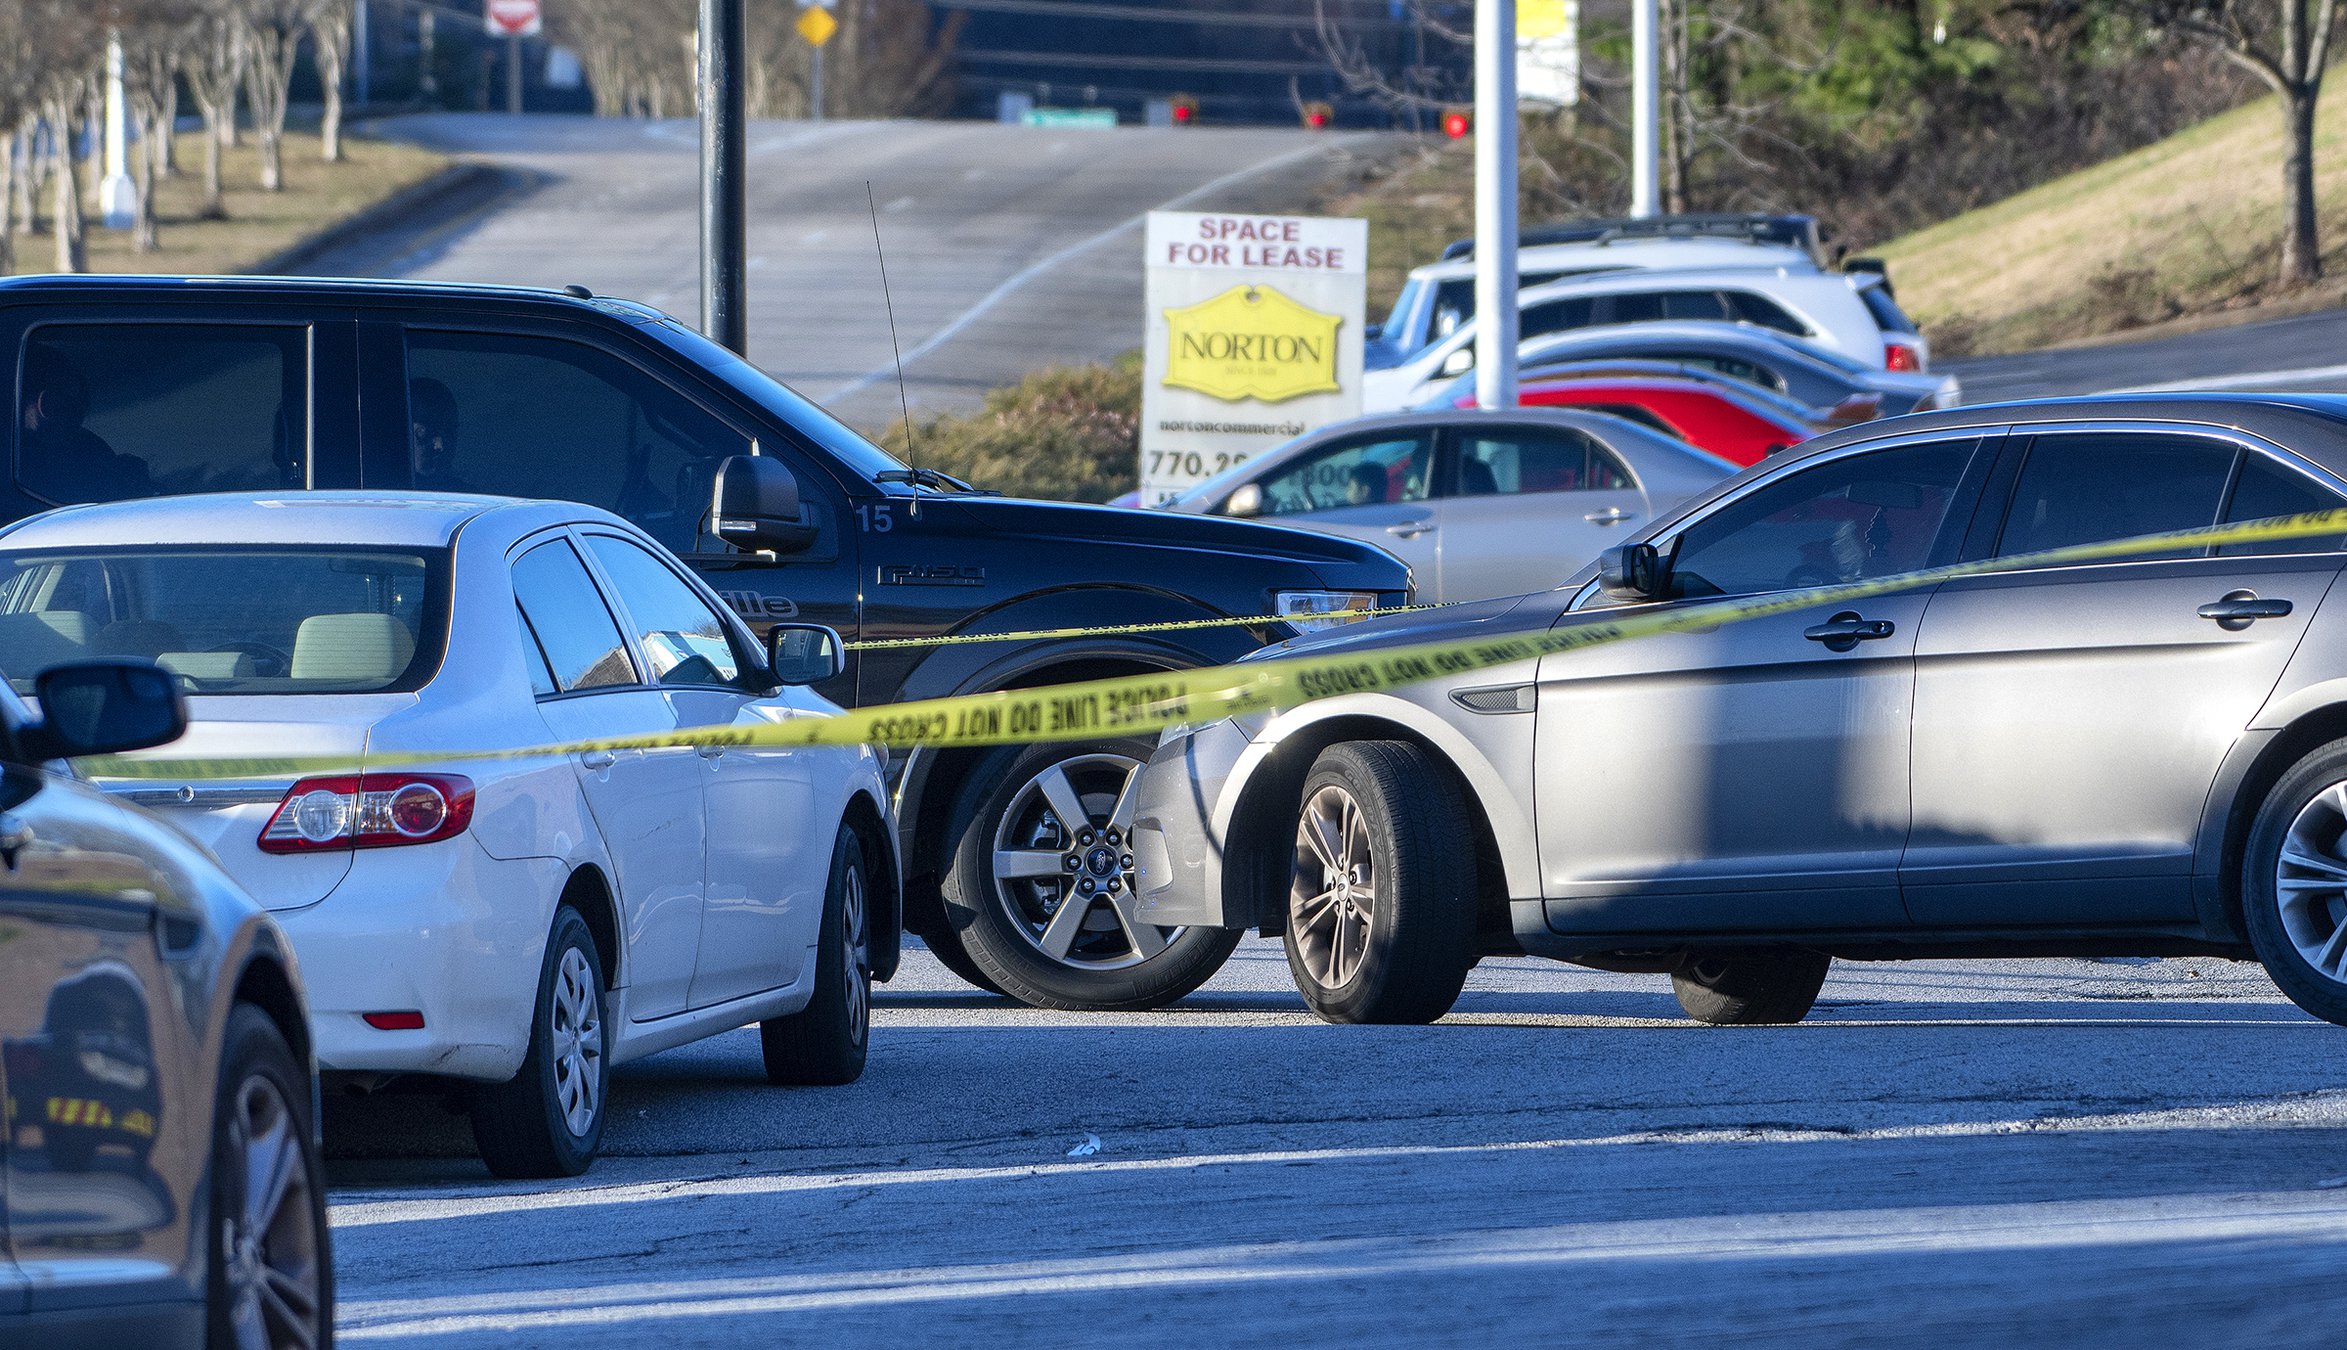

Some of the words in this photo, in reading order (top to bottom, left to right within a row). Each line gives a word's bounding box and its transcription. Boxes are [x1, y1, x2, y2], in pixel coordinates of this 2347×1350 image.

[1199, 217, 1300, 242] SPACE
[1168, 241, 1230, 266] FOR
[1242, 246, 1345, 269] LEASE
[1180, 331, 1323, 364] NORTON
[856, 504, 894, 533] 15
[1384, 653, 1432, 684] NOT
[1433, 648, 1474, 673] DO
[1297, 662, 1381, 698] CROSS
[1011, 700, 1042, 735] DO
[1050, 694, 1100, 732] LINE
[1107, 681, 1190, 725] POLICE
[868, 712, 948, 742] CROSS
[955, 705, 1001, 736] NOT
